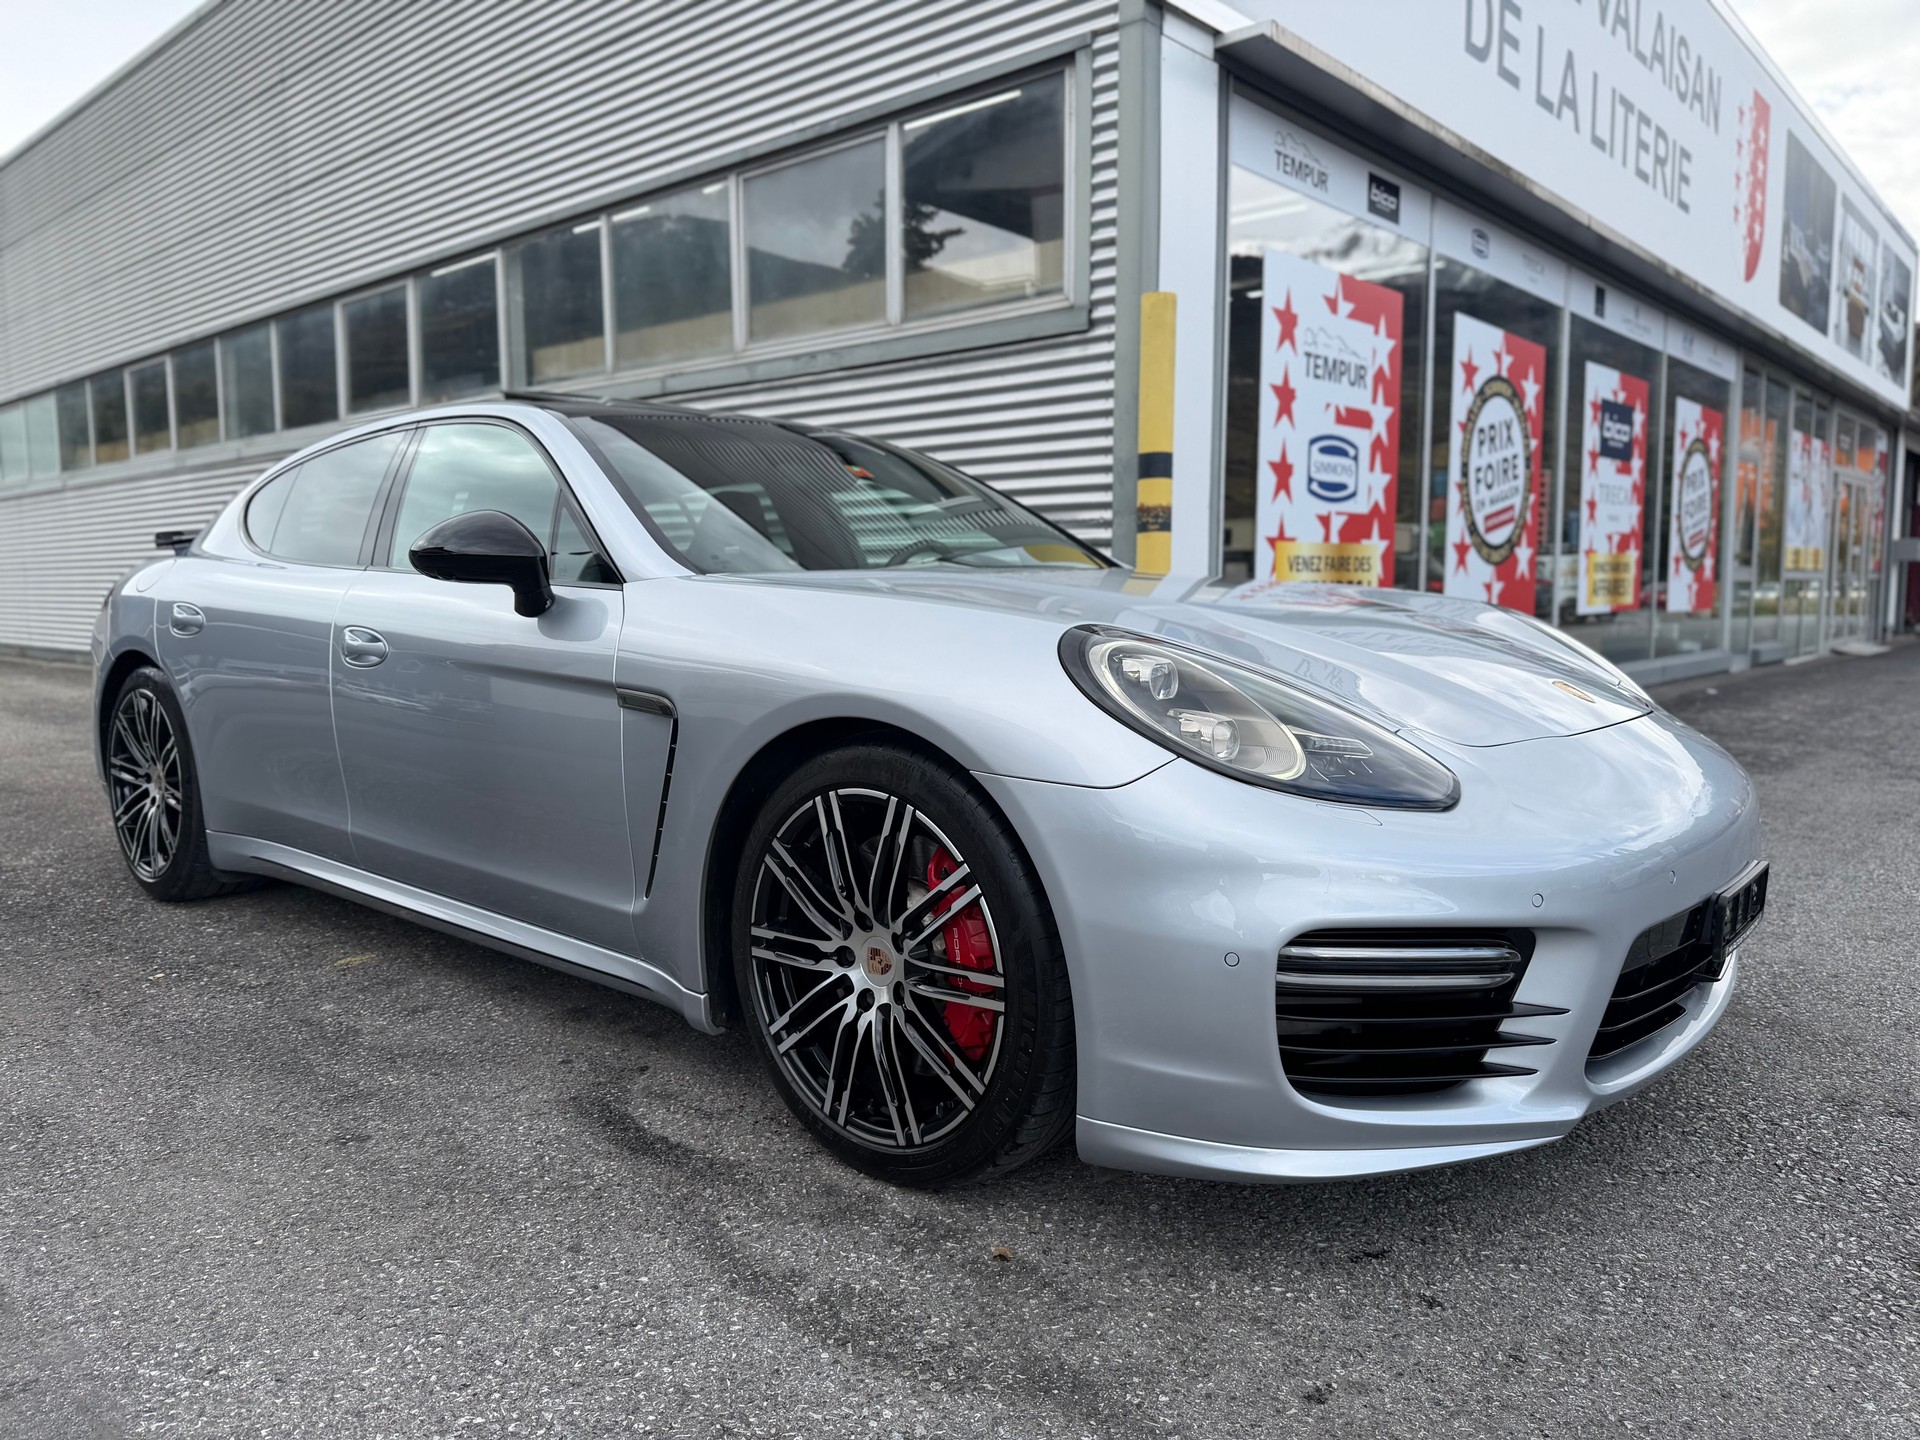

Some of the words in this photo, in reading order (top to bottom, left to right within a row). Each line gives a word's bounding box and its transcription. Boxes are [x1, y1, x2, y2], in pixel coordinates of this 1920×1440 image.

[1465, 0, 1522, 91] DE
[1535, 24, 1580, 135] LA
[1590, 70, 1693, 215] LITERIE
[1274, 148, 1329, 193] TEMPUR
[1304, 351, 1367, 390] TEMPUR
[1478, 417, 1515, 458] PRIX
[1313, 460, 1354, 479] SIMMONS
[1475, 453, 1519, 495] FOIRE
[1287, 555, 1322, 573] VENEZ
[1325, 555, 1351, 573] FAIRE
[1353, 556, 1372, 573] DES
